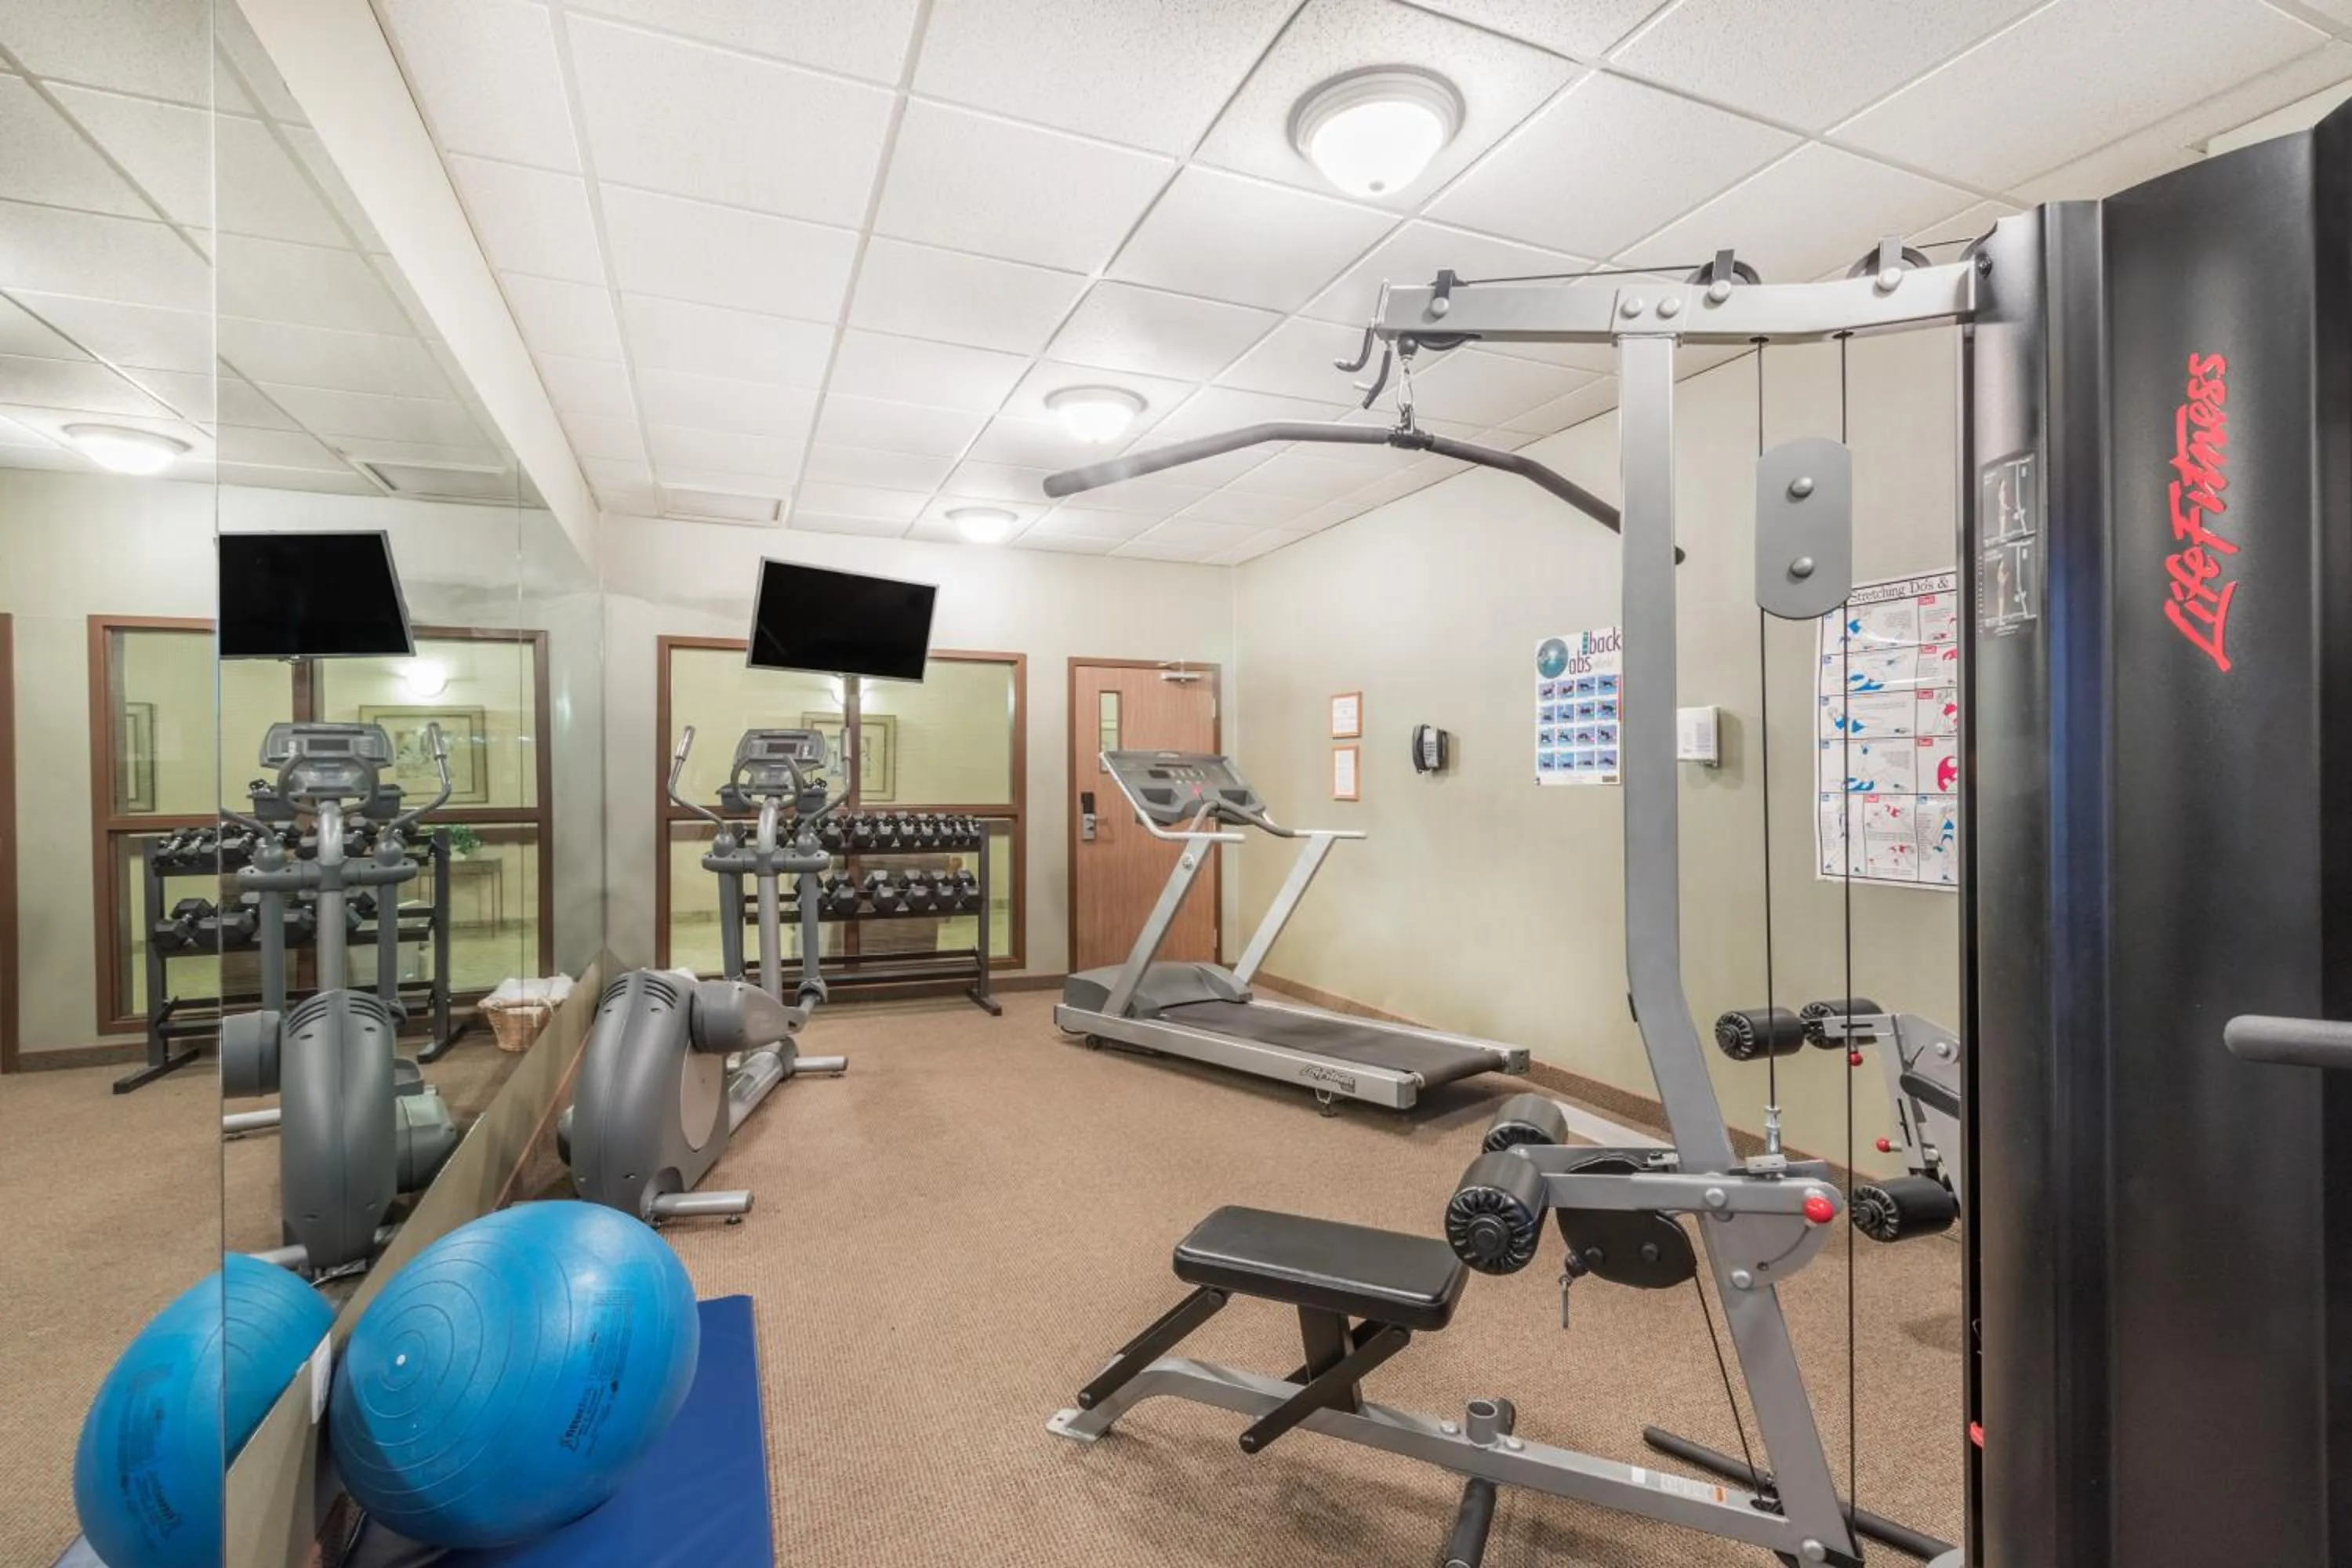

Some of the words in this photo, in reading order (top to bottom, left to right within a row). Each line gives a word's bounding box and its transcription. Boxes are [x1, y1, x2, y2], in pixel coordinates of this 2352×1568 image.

[1849, 586, 1905, 603] Stretching
[1937, 576, 1950, 589] &
[1589, 626, 1621, 655] back
[1569, 648, 1592, 675] abs
